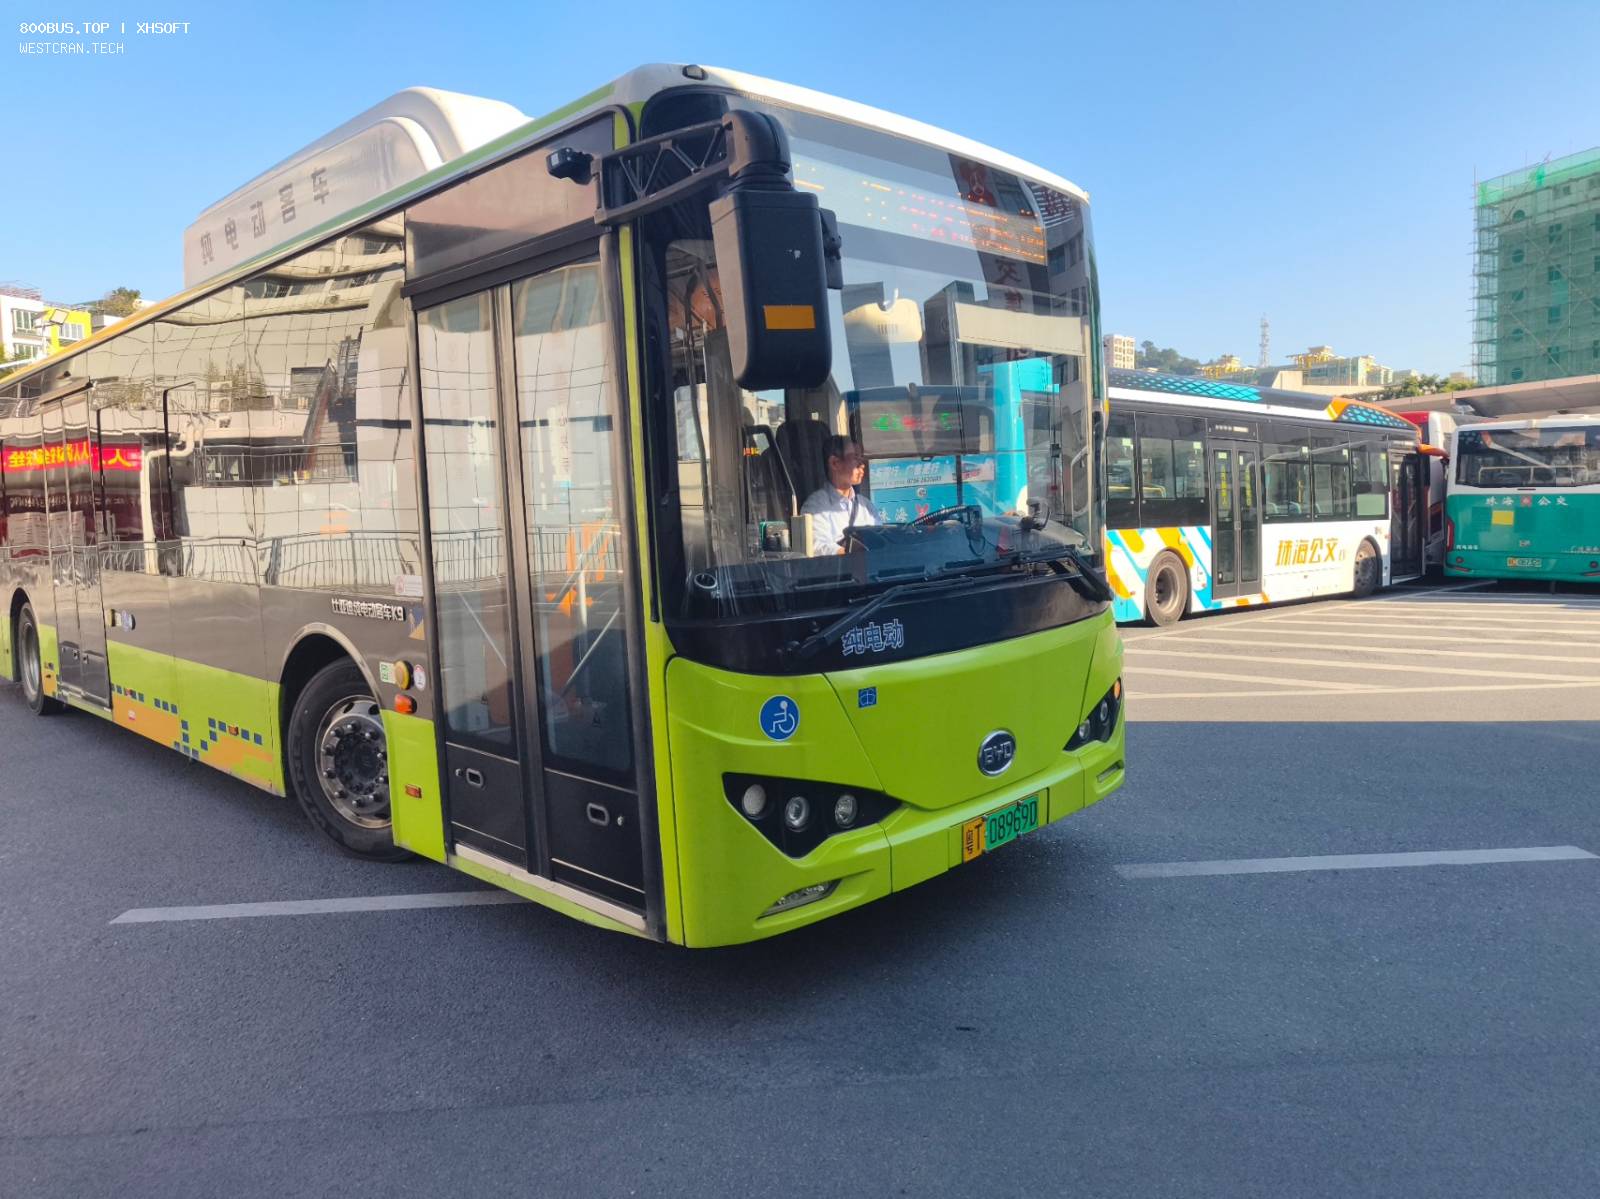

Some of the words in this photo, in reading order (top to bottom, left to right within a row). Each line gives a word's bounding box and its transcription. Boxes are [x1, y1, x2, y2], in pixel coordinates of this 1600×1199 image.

[200, 167, 330, 266] 纯电动客车
[841, 618, 905, 656] 纯电动
[983, 740, 1012, 765] BYD
